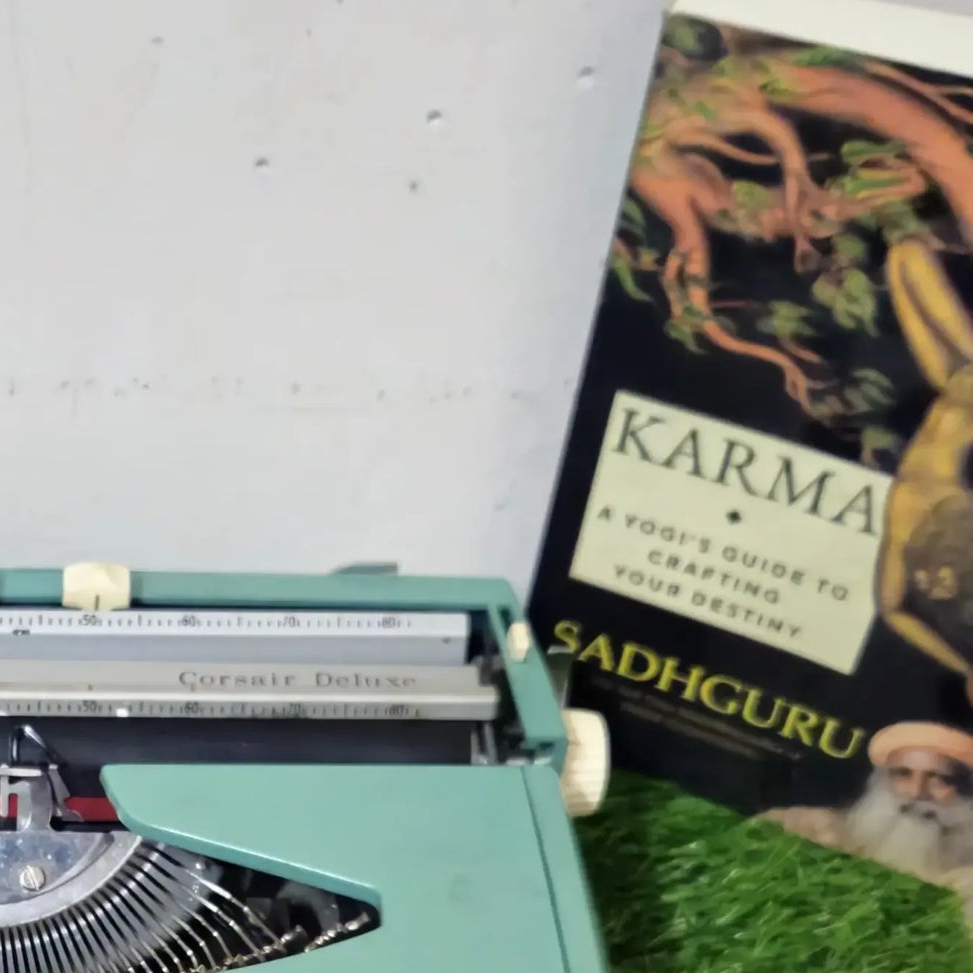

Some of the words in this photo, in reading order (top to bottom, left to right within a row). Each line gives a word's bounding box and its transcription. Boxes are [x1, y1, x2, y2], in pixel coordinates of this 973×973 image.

[612, 408, 877, 536] KARMA
[597, 505, 612, 521] A
[625, 514, 710, 555] YOGI'S
[722, 545, 804, 586] GUIDE
[817, 578, 850, 602] TO
[646, 549, 780, 604] CRAFTING
[613, 565, 682, 597] YOUR
[690, 590, 803, 639] DESTINY
[179, 671, 295, 687] Corsair
[315, 672, 417, 688] Deluxe
[554, 619, 865, 759] SADHGURU
